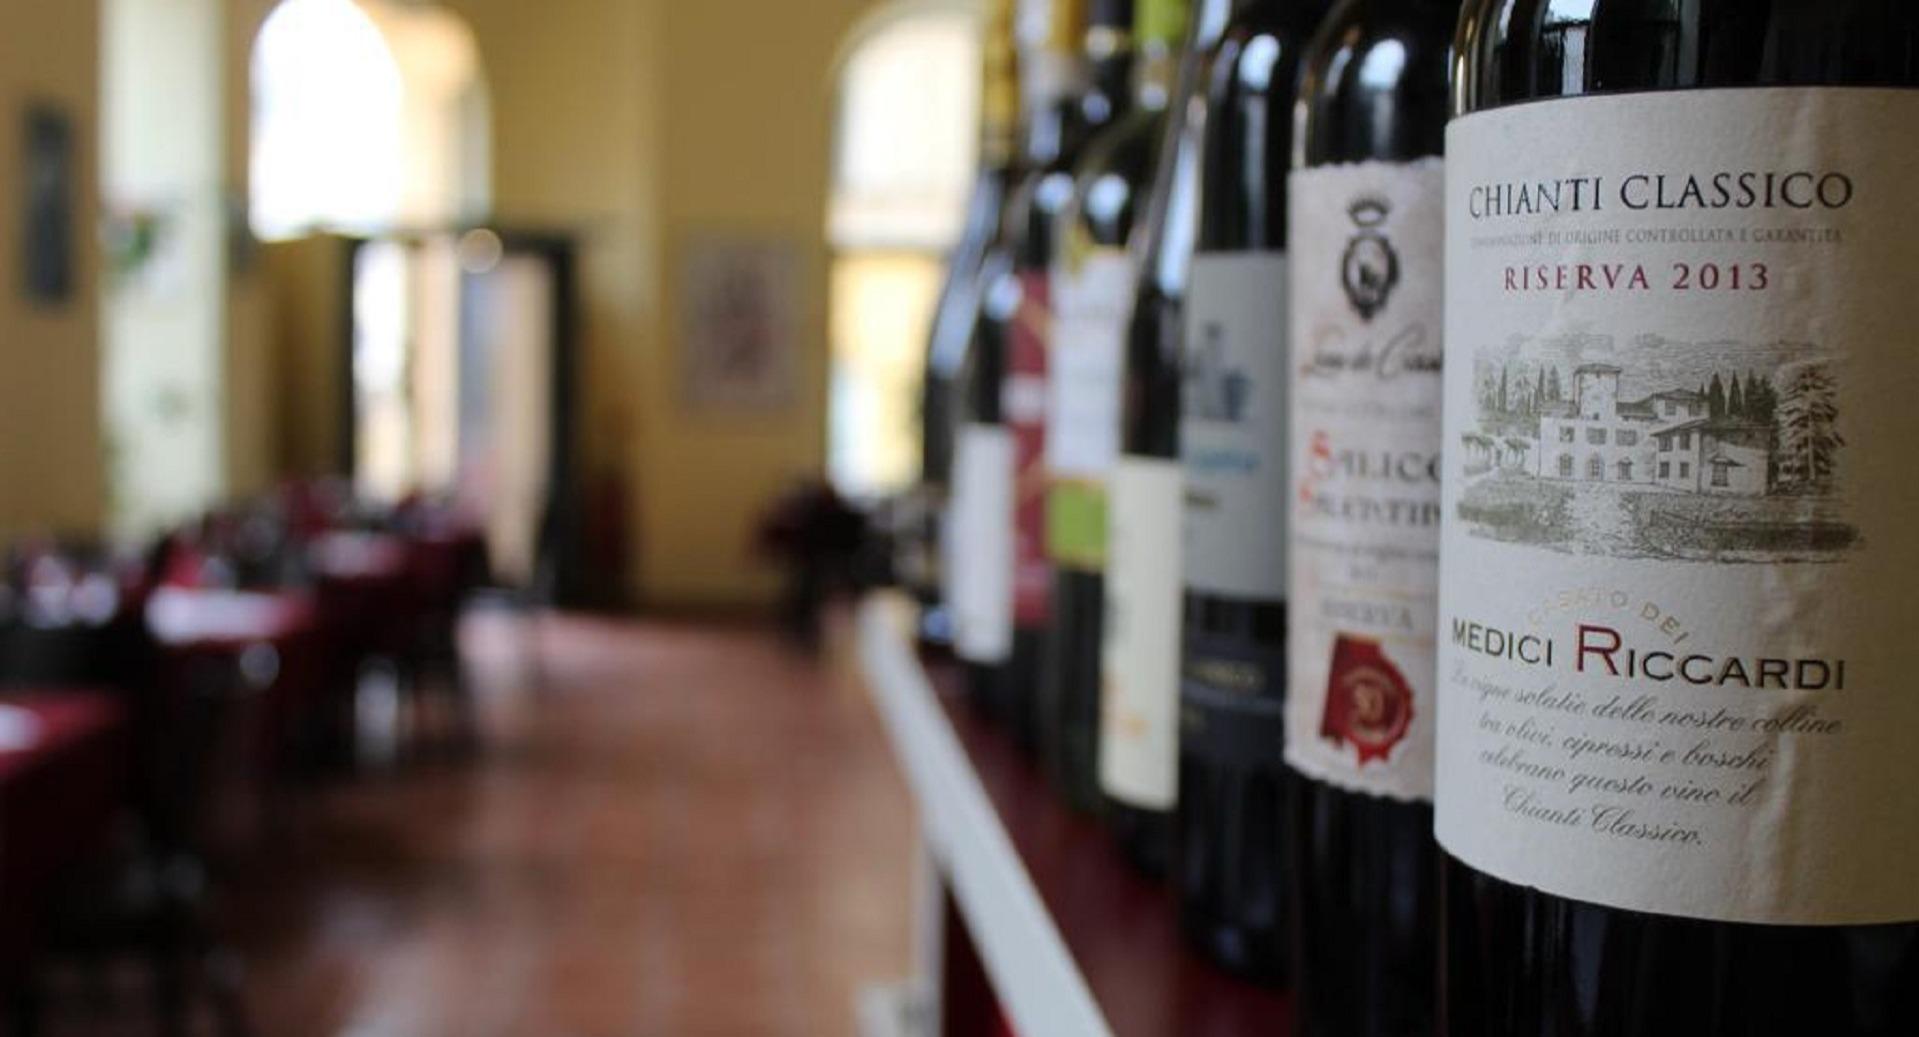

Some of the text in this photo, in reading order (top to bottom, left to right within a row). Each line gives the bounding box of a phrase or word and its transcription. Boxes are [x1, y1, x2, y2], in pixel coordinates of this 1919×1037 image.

[1469, 171, 1855, 219] CHIANTI CLASSICO
[1548, 230, 1561, 245] DI
[1565, 229, 1620, 245] ORIGINE
[1625, 228, 1734, 243] CONTROLLATA
[1736, 228, 1747, 242] E
[1752, 227, 1843, 243] GARANTITA
[1504, 263, 1770, 291] RISERVA 2013
[1451, 617, 1554, 668] MEDICI
[1639, 601, 1690, 645] DEI
[1591, 696, 1656, 721] delle
[1658, 708, 1746, 731] nostre
[1752, 704, 1842, 735] colline
[1562, 732, 1660, 760] cipressi
[1660, 751, 1676, 764] e
[1681, 740, 1776, 769] boschi
[1503, 784, 1587, 826] Chianti
[1568, 774, 1654, 795] questo
[1659, 779, 1720, 802] vino
[1727, 777, 1767, 808] il
